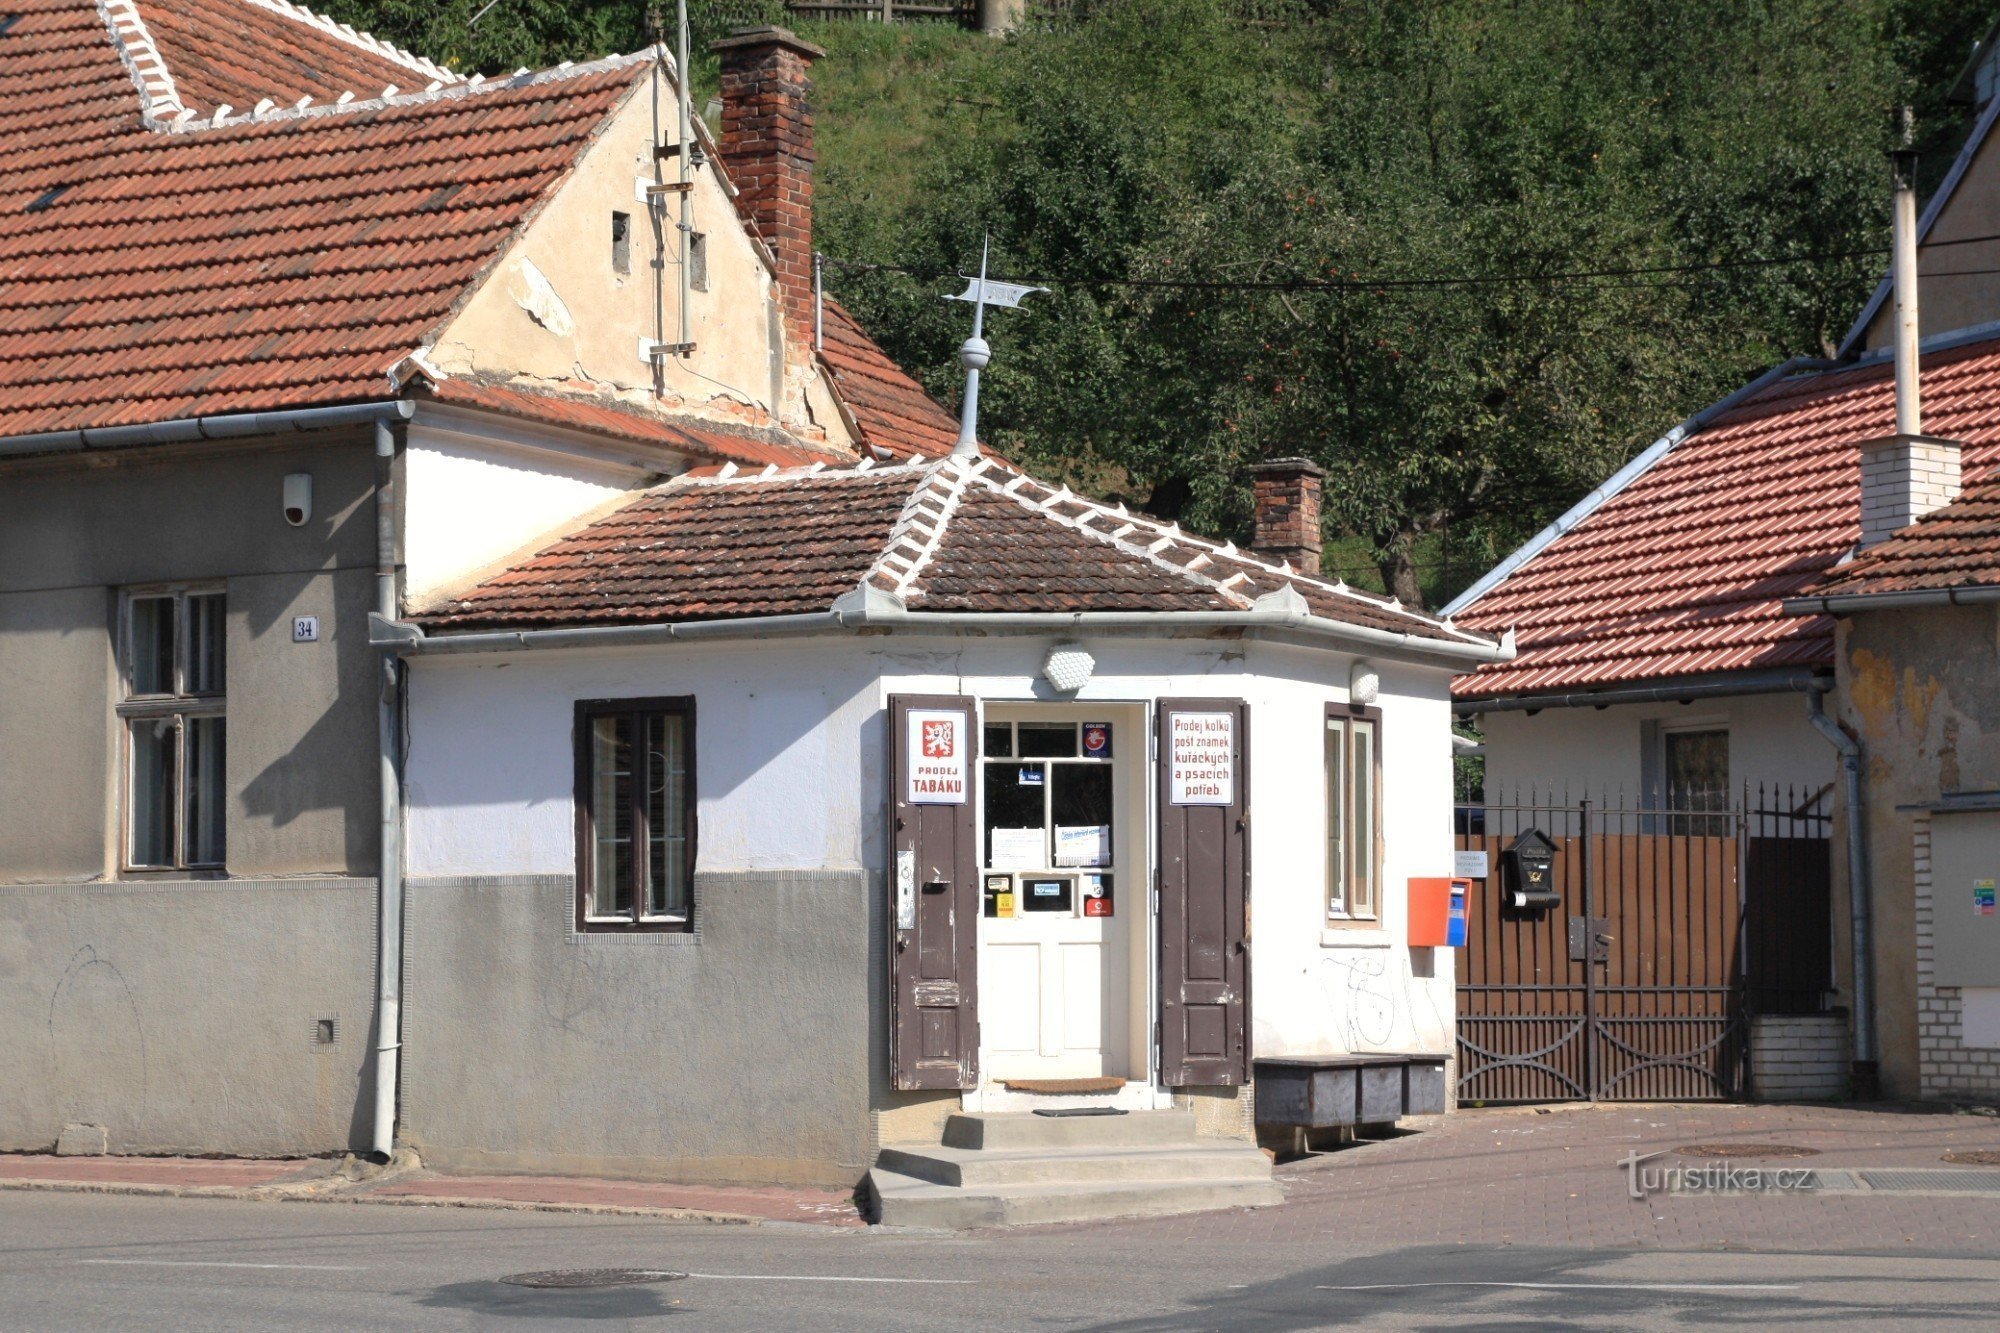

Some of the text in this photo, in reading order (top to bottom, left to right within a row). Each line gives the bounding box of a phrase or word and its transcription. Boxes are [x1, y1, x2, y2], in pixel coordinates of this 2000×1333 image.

[298, 621, 312, 637] 34
[1175, 719, 1229, 734] Prodej kolků
[1196, 735, 1229, 748] známek
[1175, 751, 1229, 767] kuřáckých
[918, 766, 958, 775] PRODEJ
[1175, 767, 1229, 782] a psacích
[912, 776, 962, 793] TABÁKU
[1185, 783, 1223, 798] potřeb.
